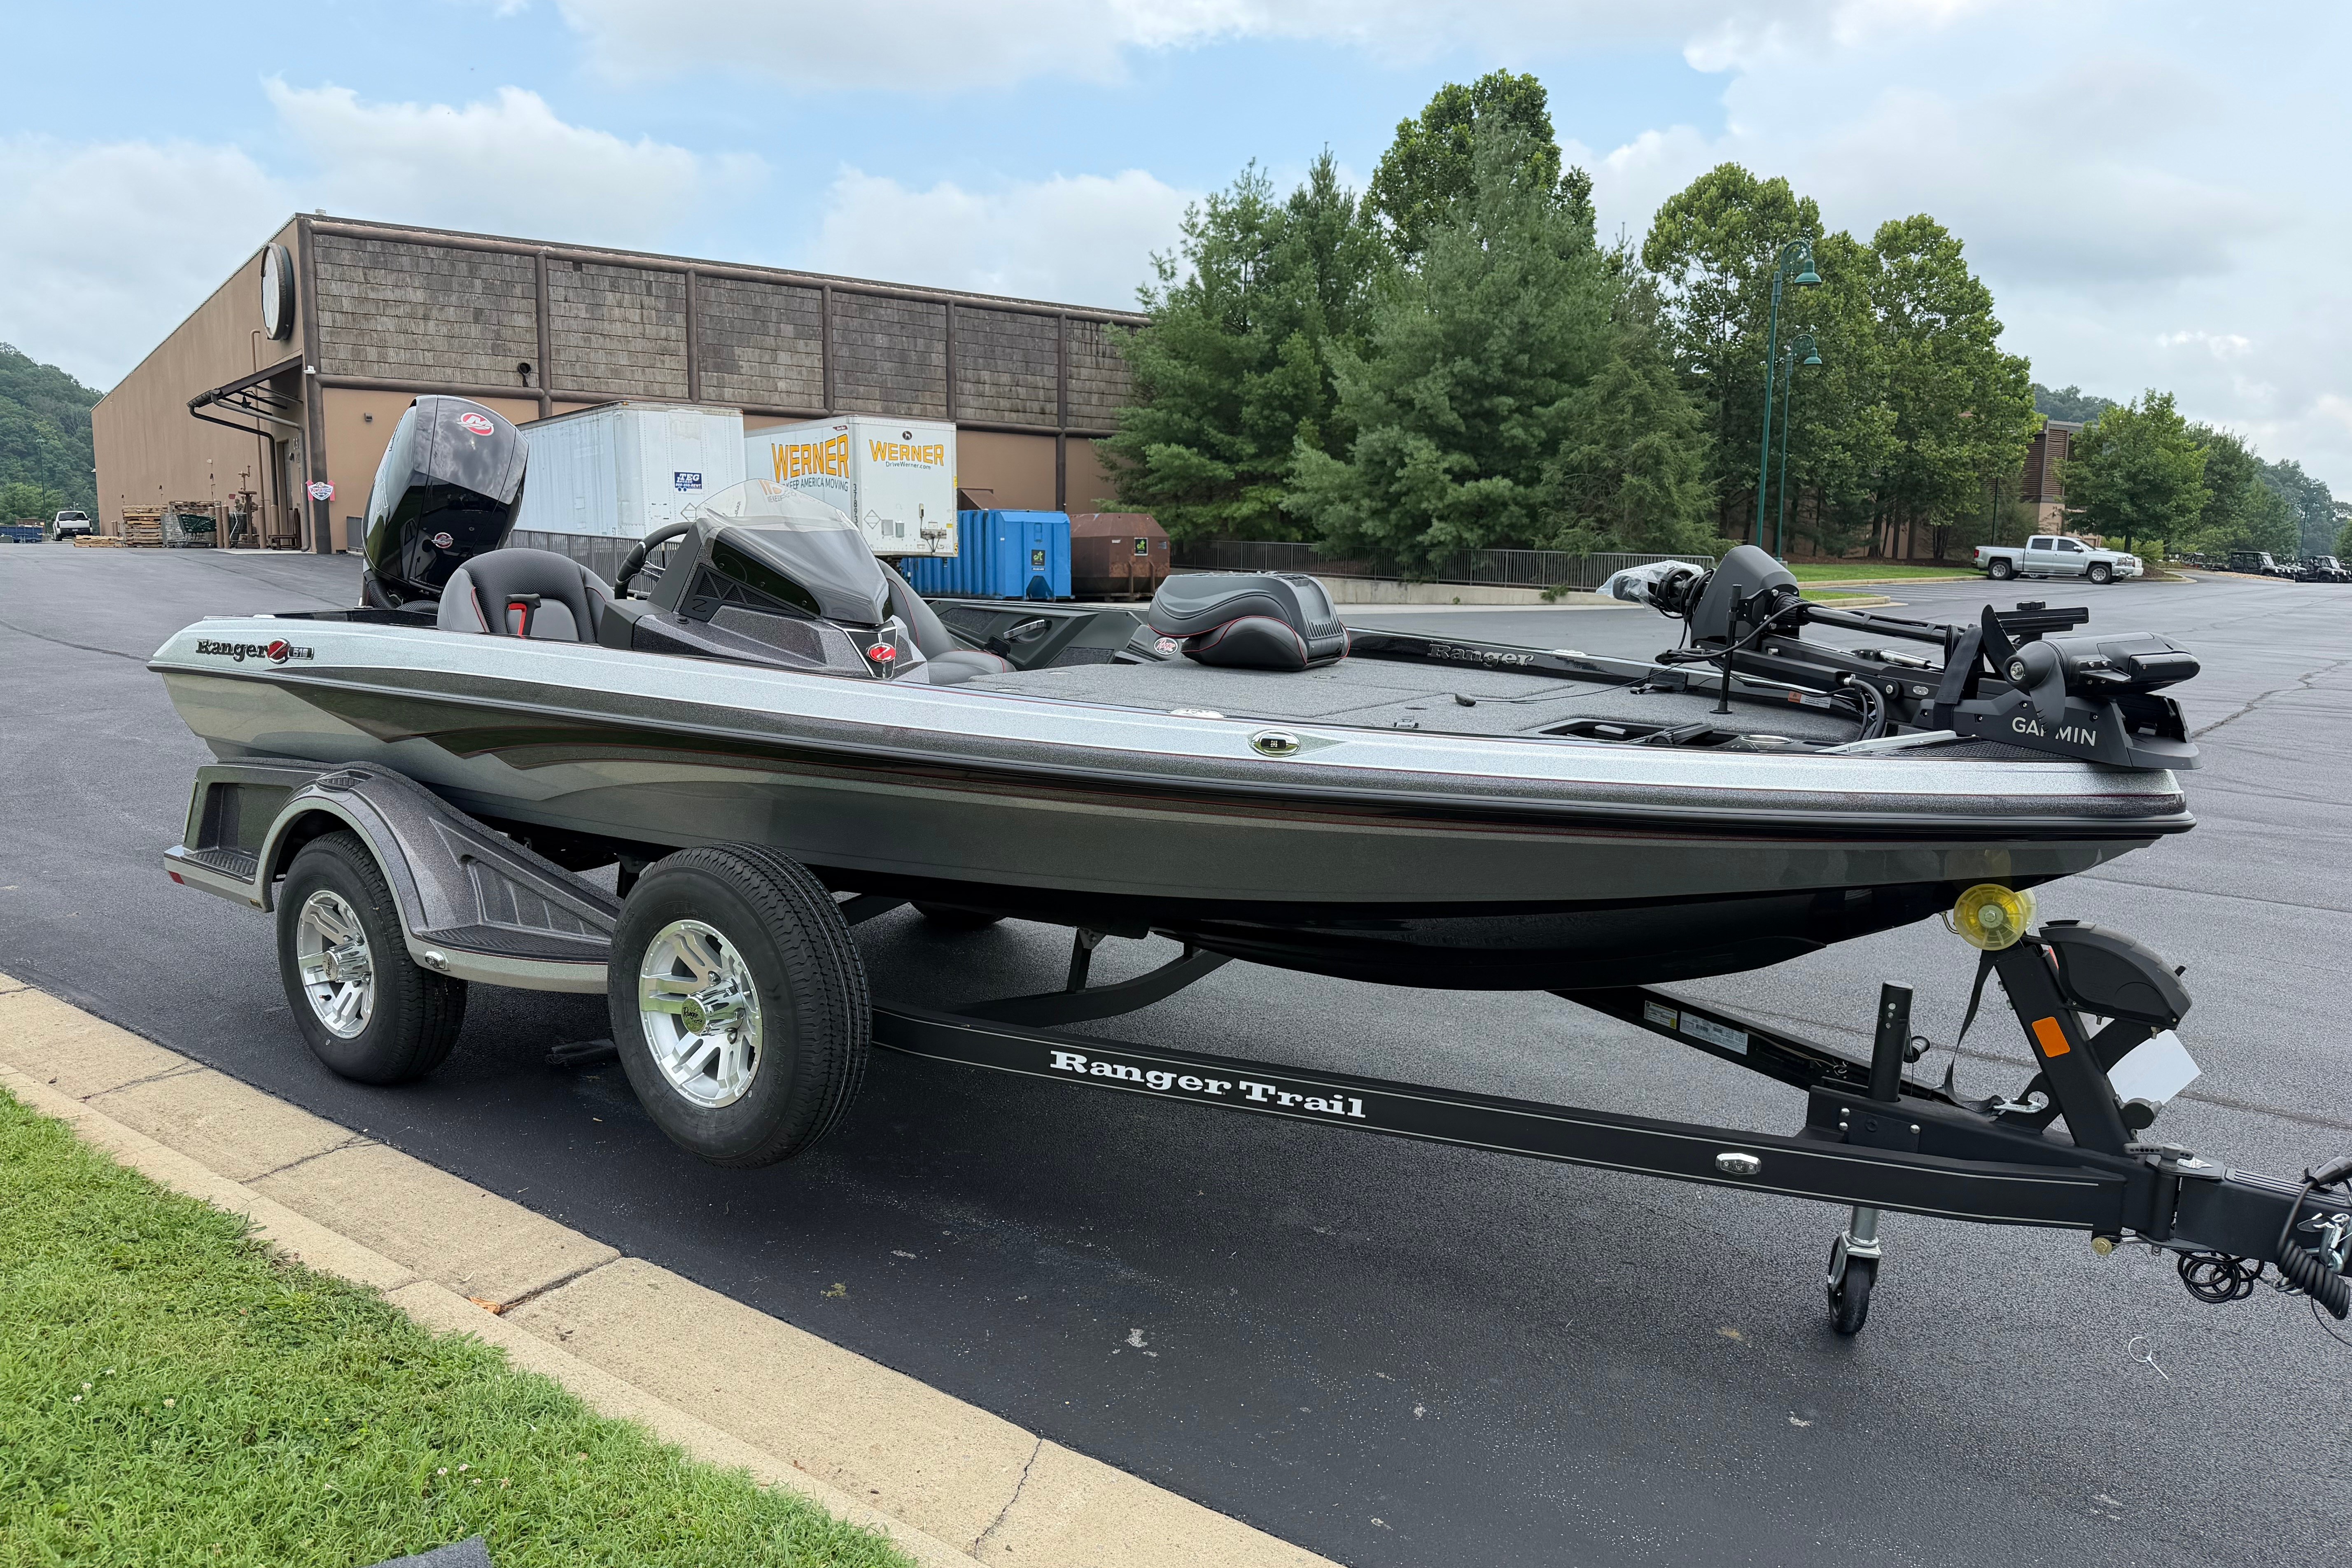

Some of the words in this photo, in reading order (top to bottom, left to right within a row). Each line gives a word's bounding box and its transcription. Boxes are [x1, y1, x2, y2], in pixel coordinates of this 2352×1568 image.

[771, 434, 849, 483] WERNER
[869, 439, 944, 466] WERNER
[679, 473, 700, 481] TEG
[886, 461, 931, 470] DriveWerner.com
[800, 477, 824, 488] AMERICA
[825, 478, 848, 492] MOVING
[196, 639, 269, 662] Ranger
[1427, 644, 1534, 668] Ranger
[2012, 717, 2096, 746] GAMIN
[1050, 1050, 1232, 1094] Ranger
[1239, 1080, 1366, 1118] Trail
